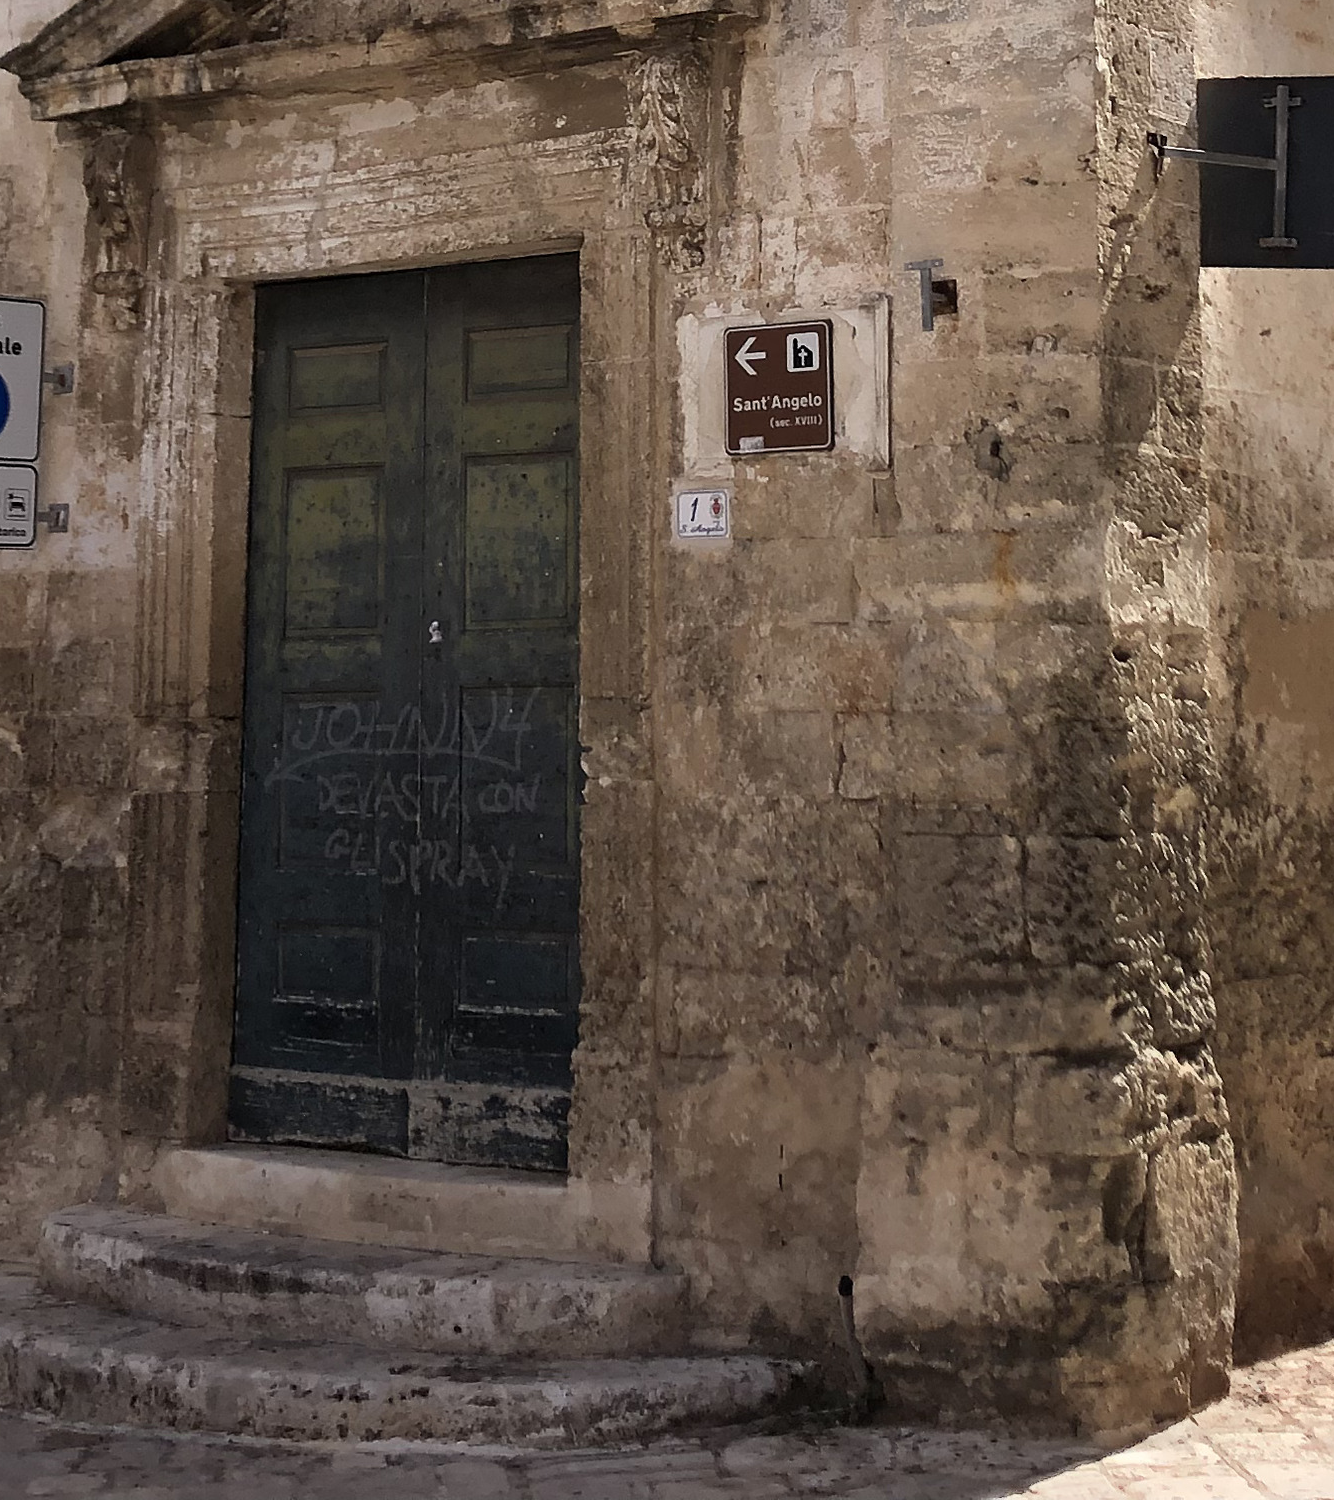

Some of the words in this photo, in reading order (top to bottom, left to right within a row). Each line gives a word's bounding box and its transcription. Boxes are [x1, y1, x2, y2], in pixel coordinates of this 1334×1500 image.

[732, 392, 823, 413] Sant'Angelo
[769, 416, 794, 429] (sec.
[795, 413, 824, 427] XVIII)
[690, 497, 699, 522] 1
